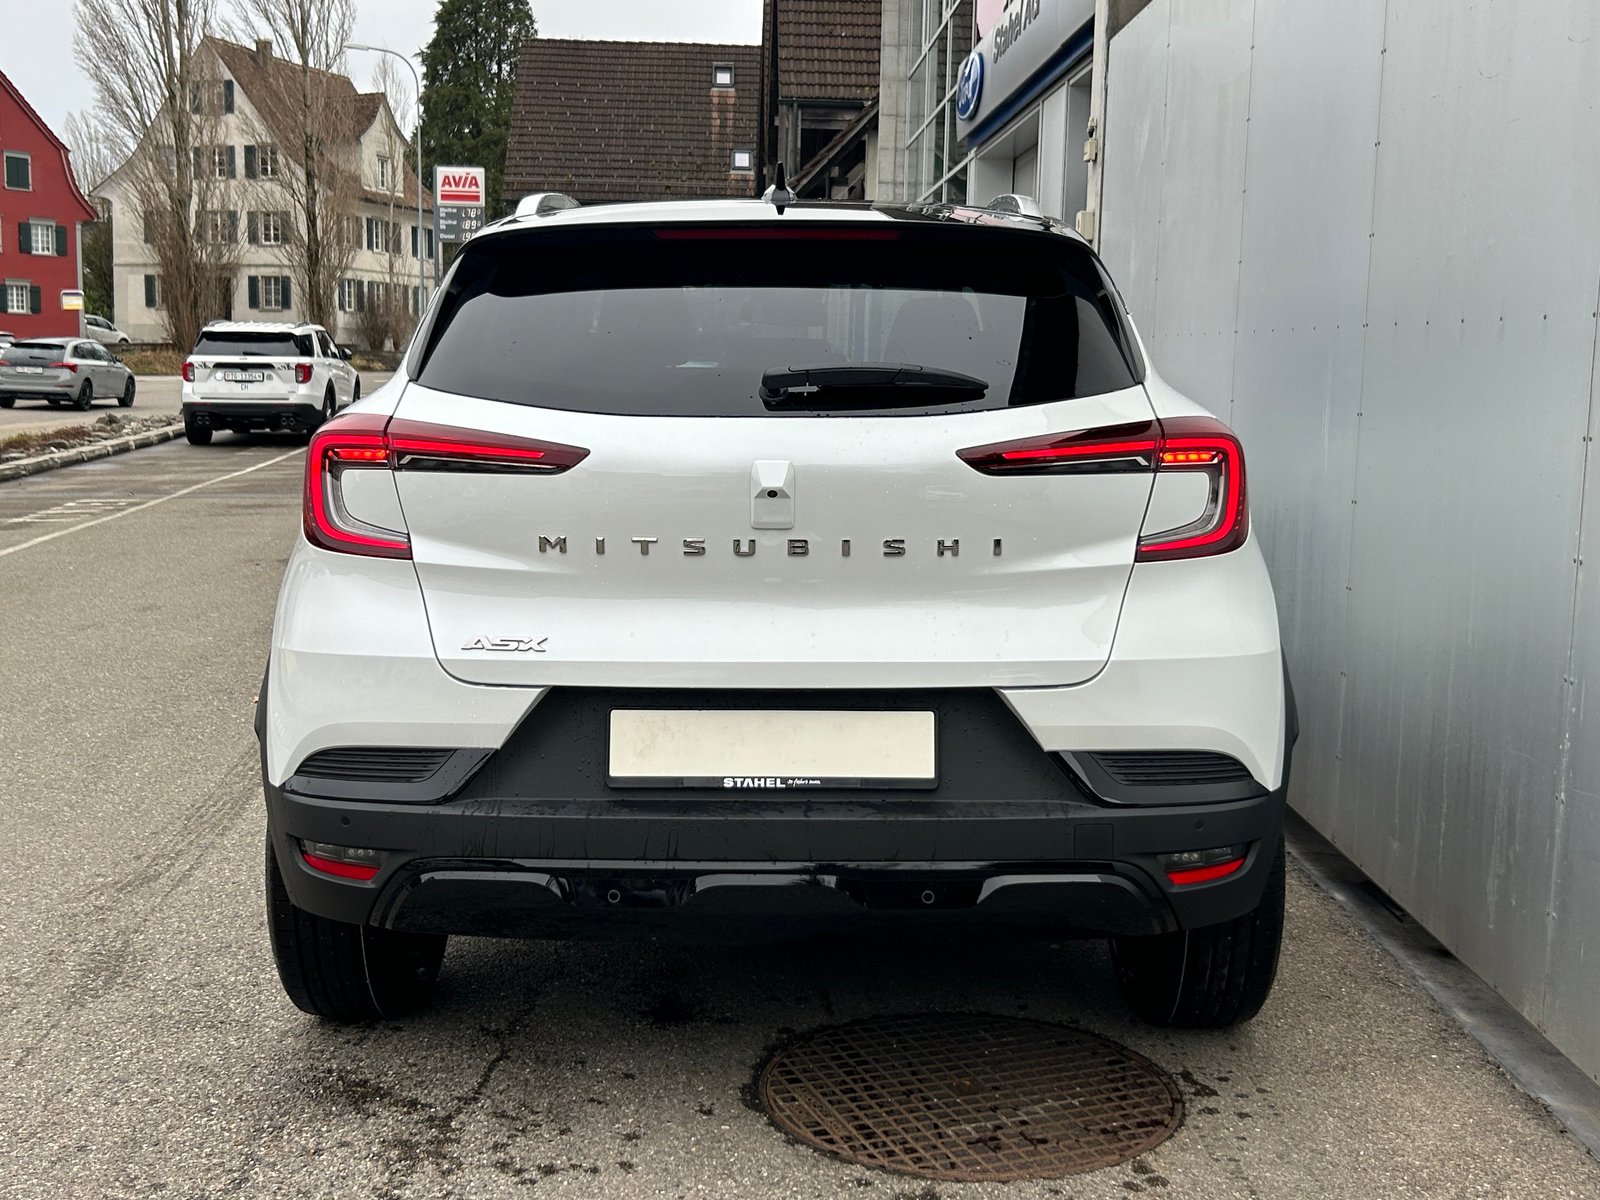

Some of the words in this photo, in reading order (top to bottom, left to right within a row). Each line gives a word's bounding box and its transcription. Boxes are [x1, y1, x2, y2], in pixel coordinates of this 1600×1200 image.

[992, 0, 1022, 64] Stahel
[240, 383, 249, 391] CH
[538, 534, 1003, 558] MITSUBISHI
[461, 635, 548, 652] ASX
[723, 778, 786, 788] STAHEL
